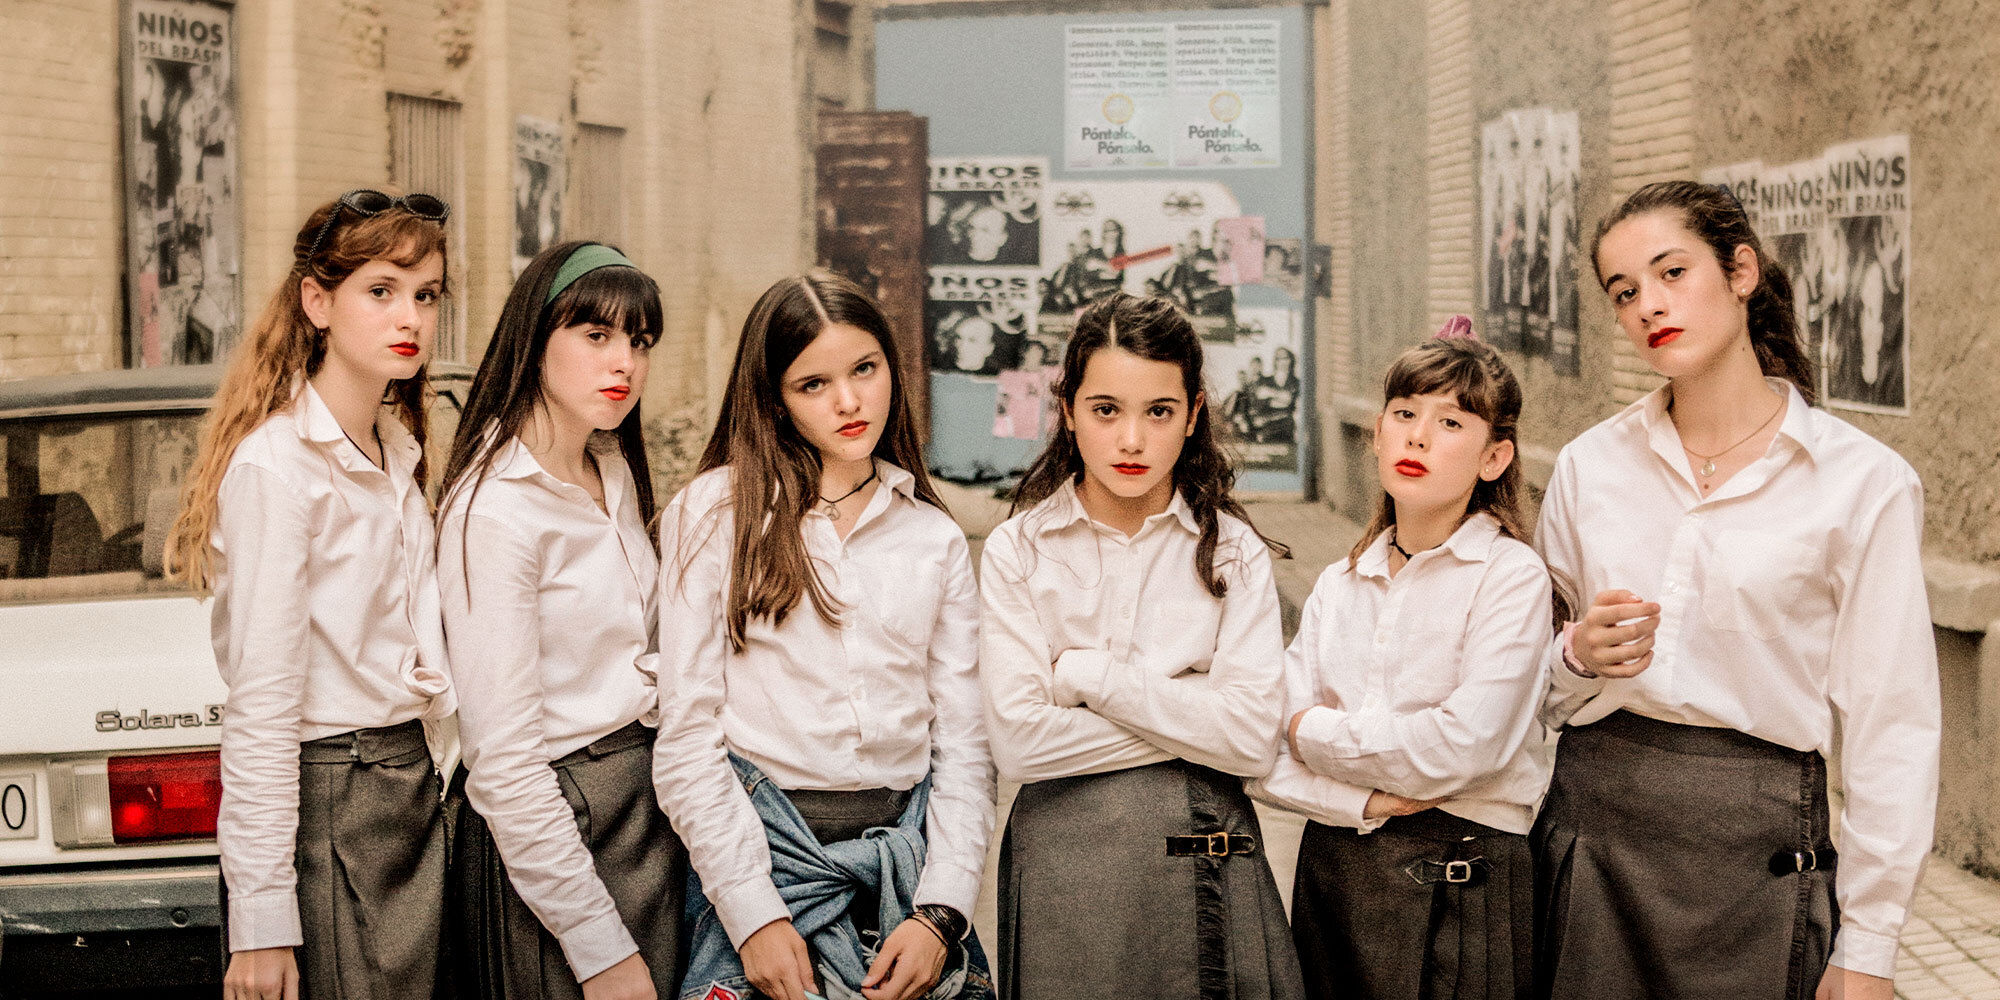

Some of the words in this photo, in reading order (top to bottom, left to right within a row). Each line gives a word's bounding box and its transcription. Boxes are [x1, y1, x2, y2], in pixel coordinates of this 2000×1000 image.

[138, 9, 223, 47] NIÑOS
[1082, 126, 1136, 140] Póntela.
[1188, 124, 1243, 139] Póntela.
[1827, 149, 1905, 193] NIÑOS
[95, 709, 203, 732] Solara
